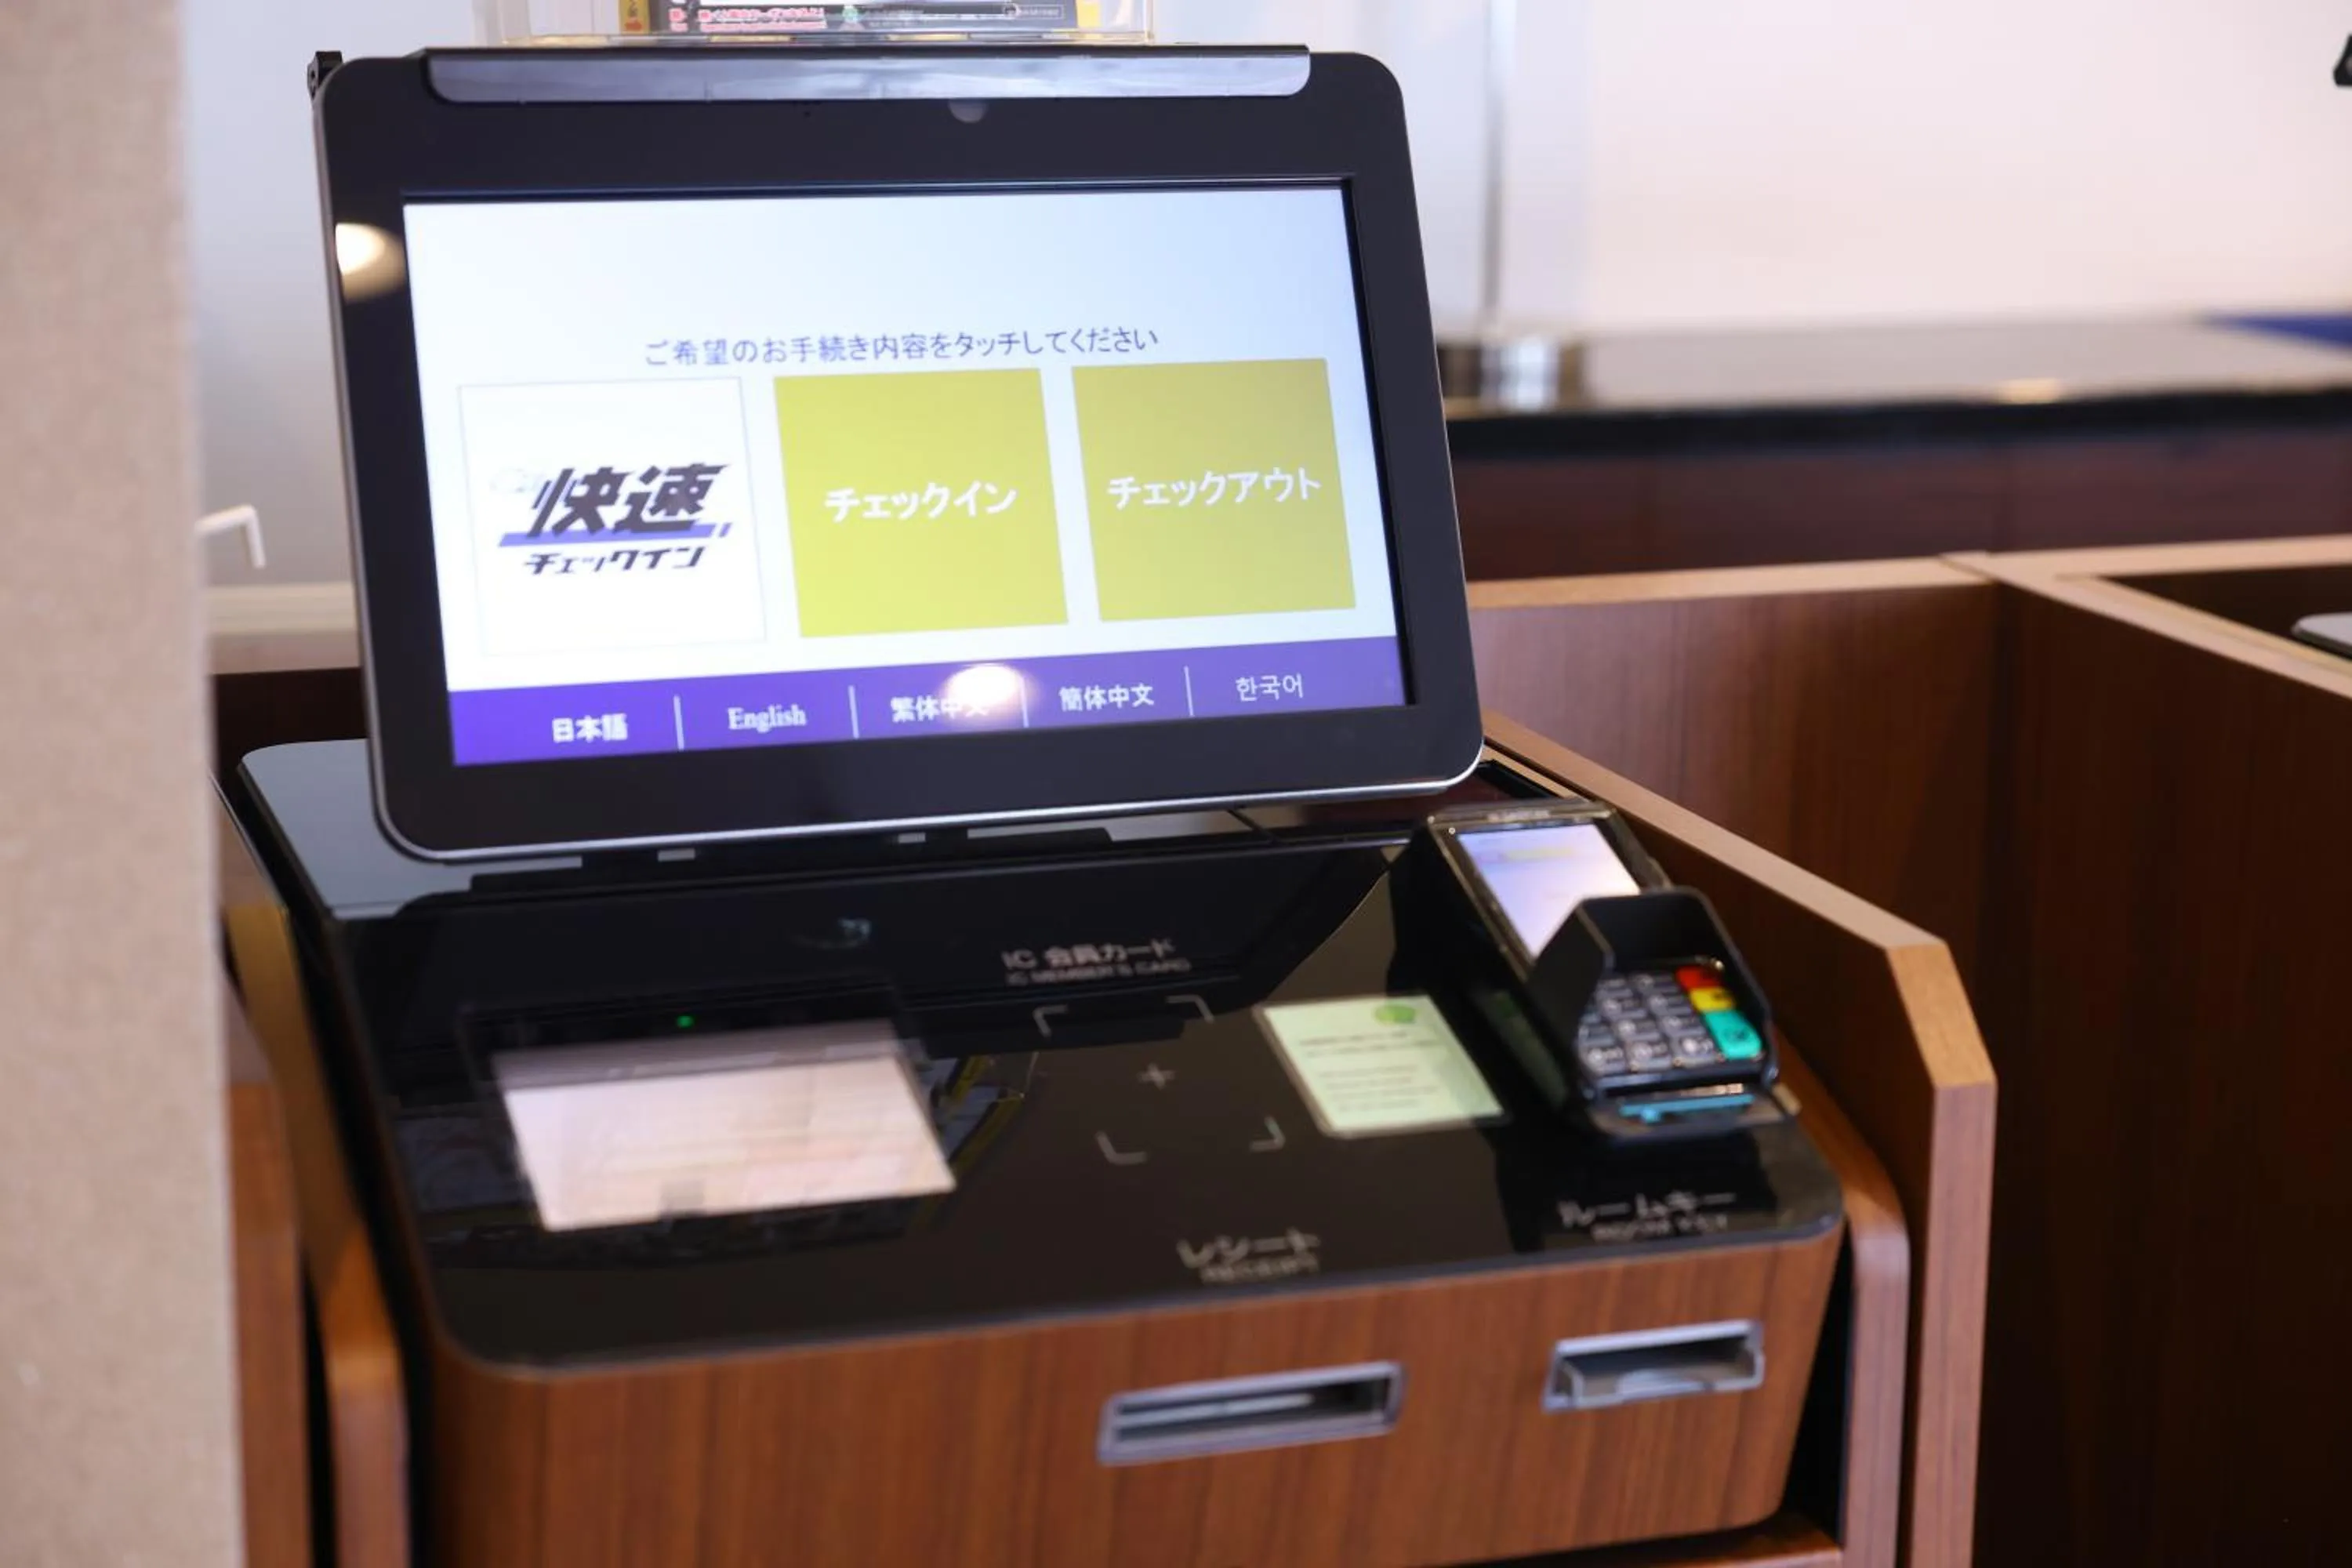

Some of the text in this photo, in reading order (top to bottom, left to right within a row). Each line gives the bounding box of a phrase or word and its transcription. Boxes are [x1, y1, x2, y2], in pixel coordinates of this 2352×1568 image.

[644, 326, 1160, 366] ご希望のお手続き内容をタッチしてください
[526, 463, 730, 539] 快速
[824, 480, 1018, 523] チェックイン
[1107, 466, 1322, 509] チェックアウト
[523, 546, 706, 575] チェックイン
[1058, 682, 1155, 712] 簡体中文
[1235, 672, 1304, 702] 한국어
[551, 713, 628, 743] 日本語
[727, 703, 807, 733] English
